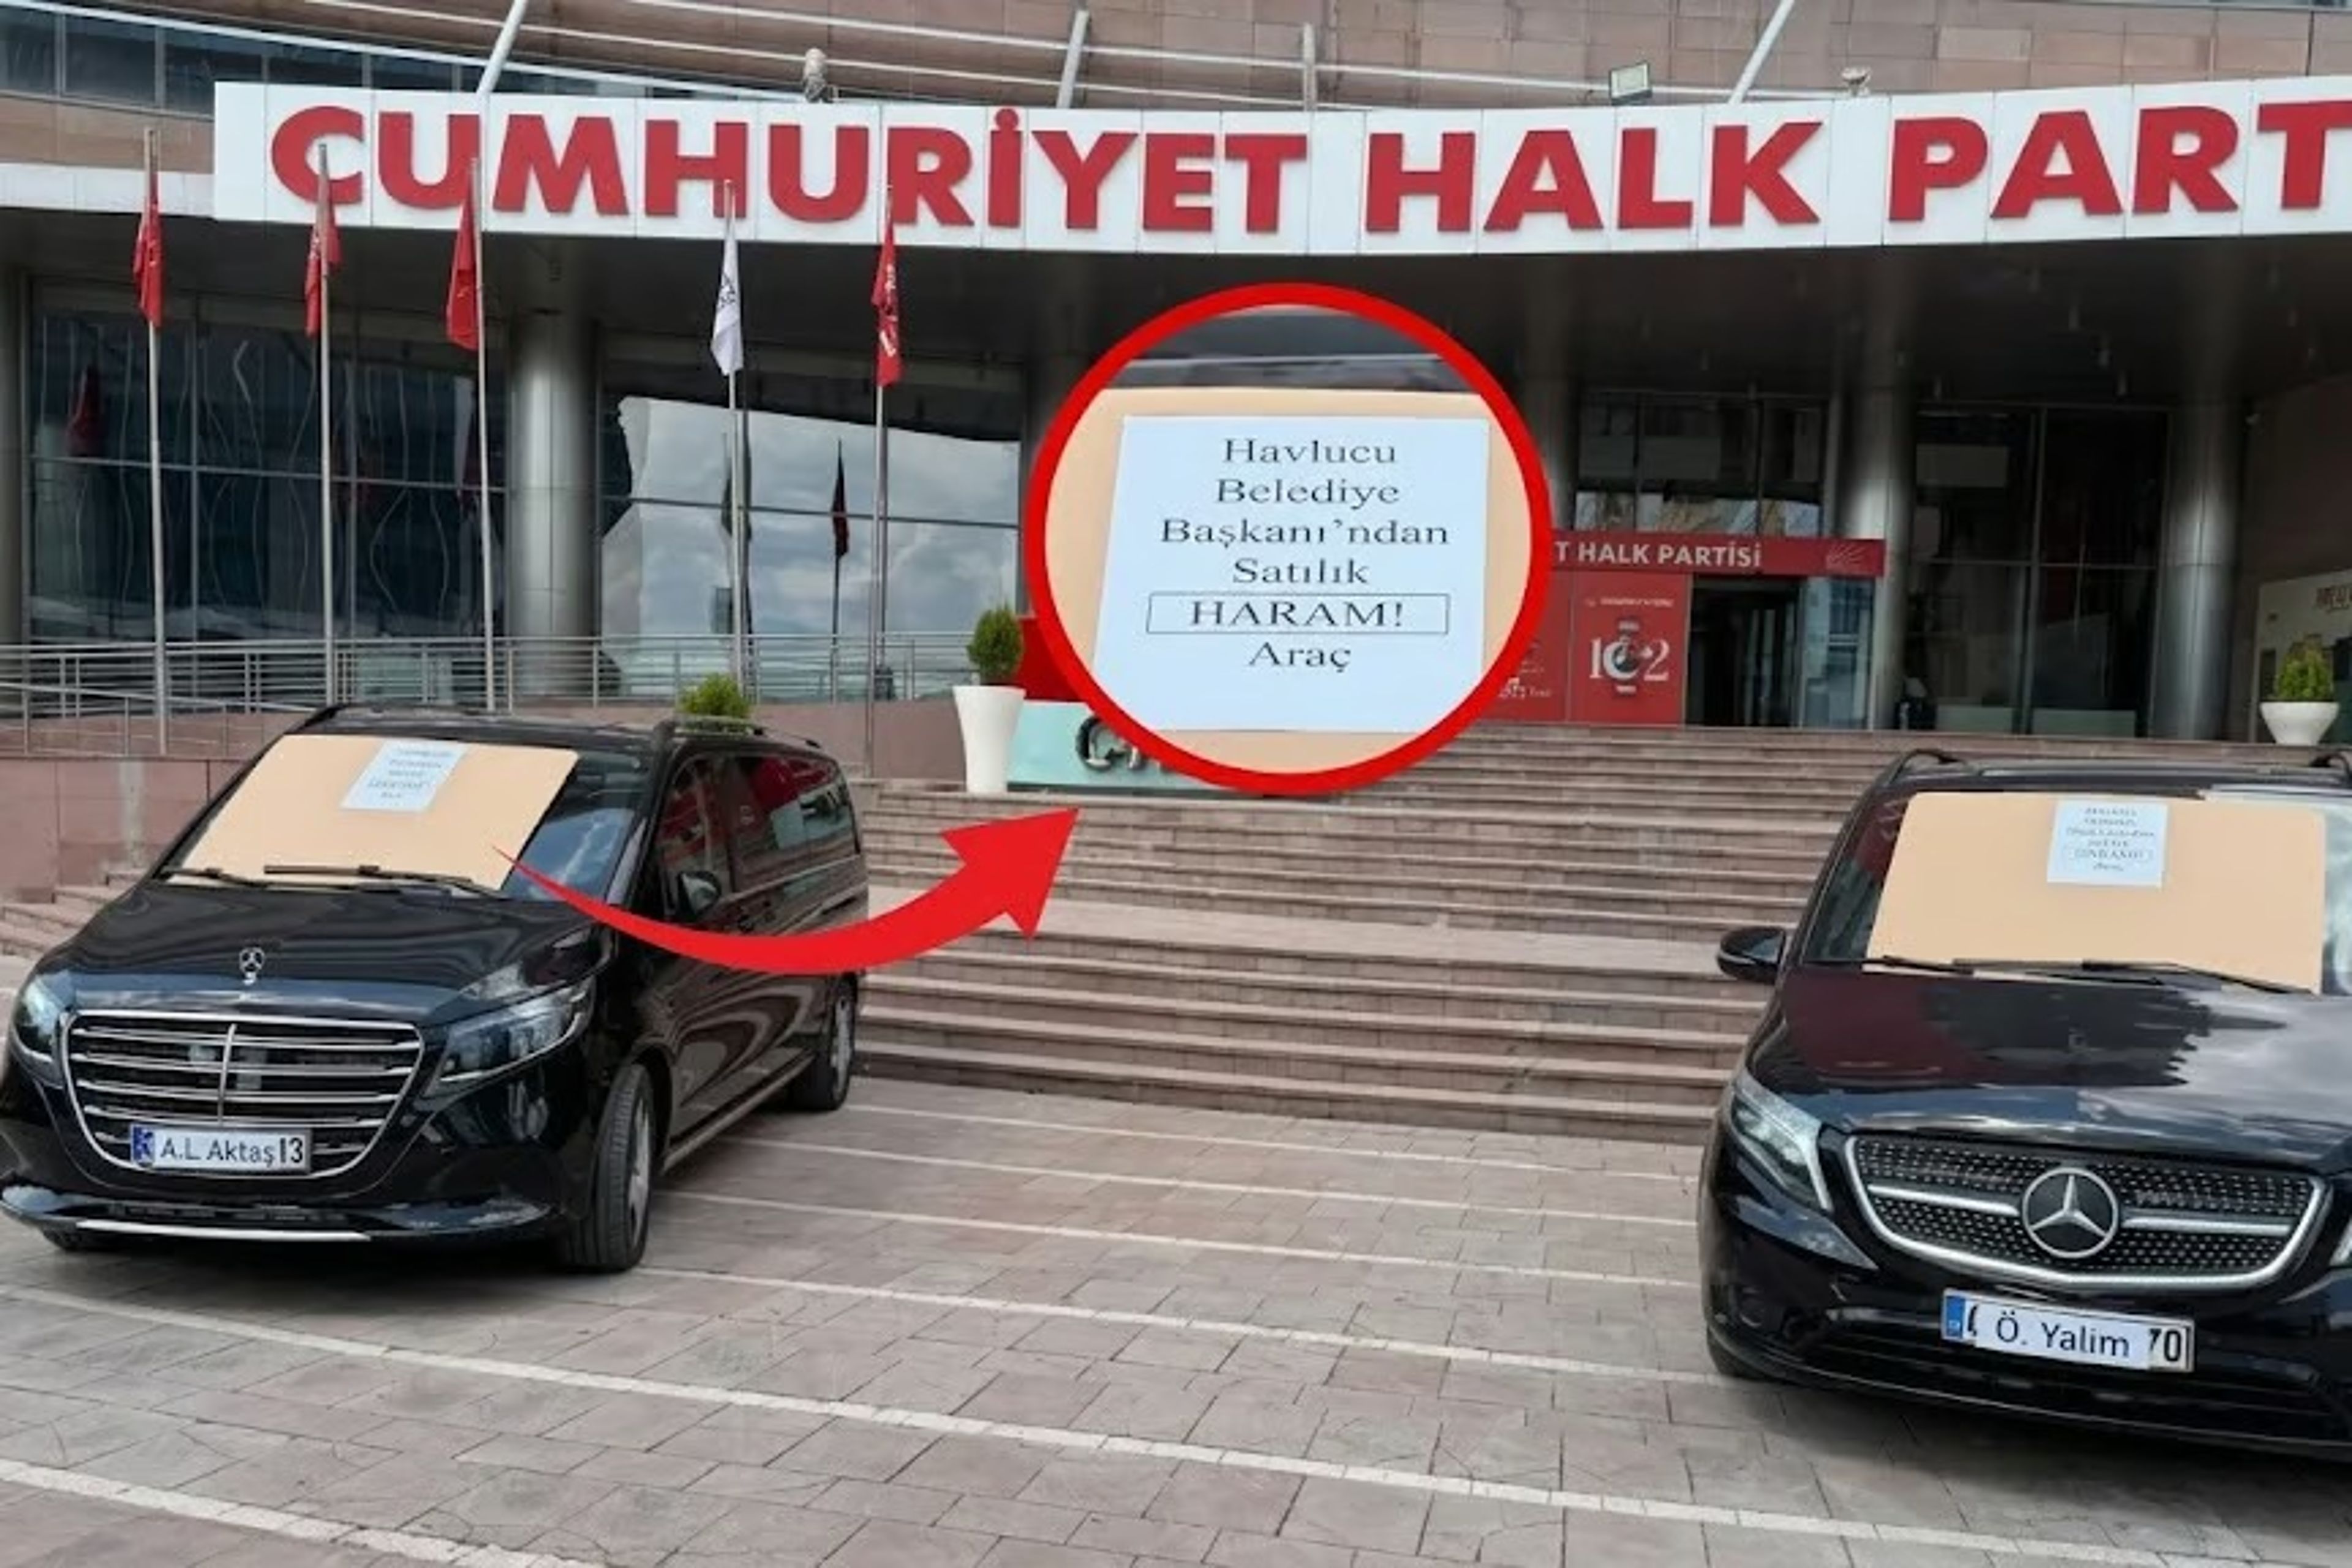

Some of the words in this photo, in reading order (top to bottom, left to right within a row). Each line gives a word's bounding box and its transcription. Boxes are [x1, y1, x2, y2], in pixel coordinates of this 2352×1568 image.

[272, 105, 1307, 233] CUMHURİYET
[1366, 122, 1823, 233] HALK
[1578, 543, 1650, 564] HALK
[206, 1139, 276, 1167] Aktaş
[2041, 1321, 2130, 1358] Yalim
